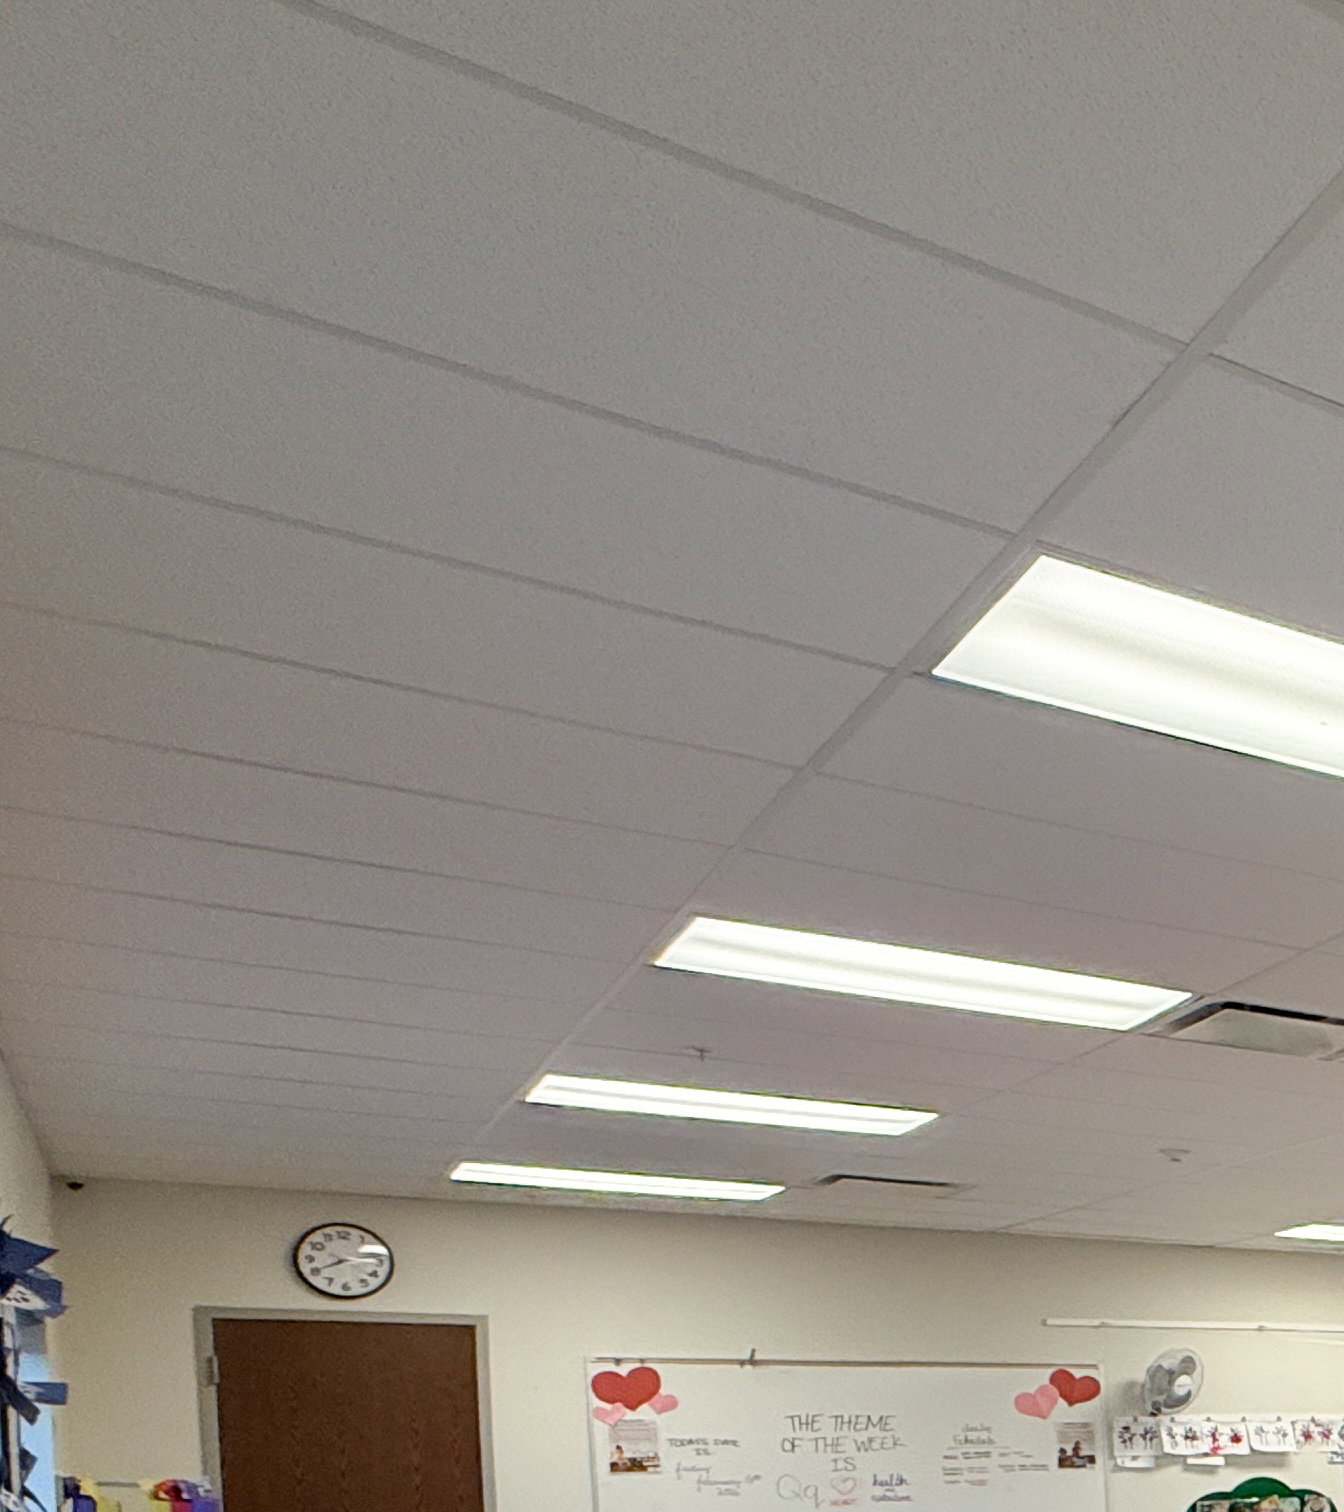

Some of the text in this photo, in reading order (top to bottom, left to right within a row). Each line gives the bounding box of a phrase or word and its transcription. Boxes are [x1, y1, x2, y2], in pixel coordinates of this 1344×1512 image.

[784, 1413, 897, 1433] THE THEME
[781, 1434, 908, 1454] OF THE WEEK
[830, 1457, 857, 1473] IS
